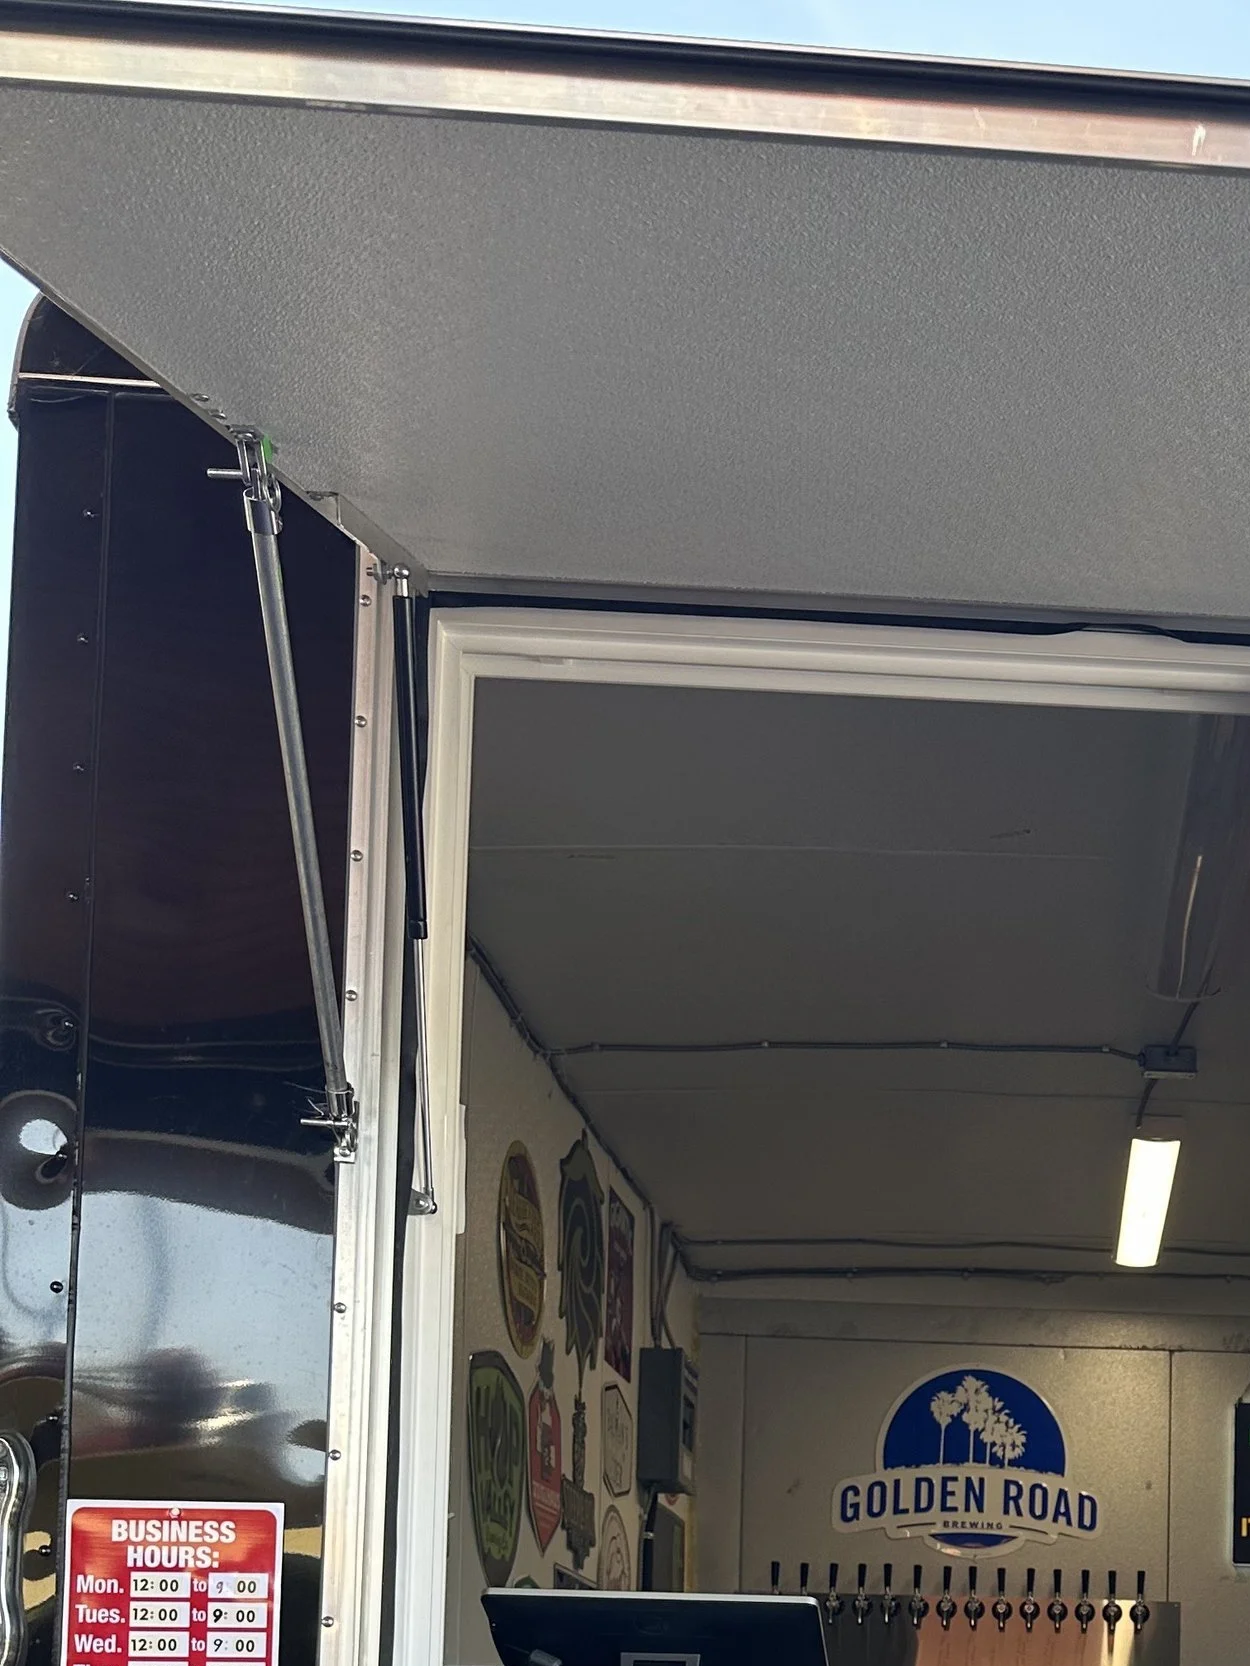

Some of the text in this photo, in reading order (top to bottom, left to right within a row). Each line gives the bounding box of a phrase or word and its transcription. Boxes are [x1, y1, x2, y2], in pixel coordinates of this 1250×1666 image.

[840, 1476, 1097, 1533] GOLDEN ROAD
[112, 1519, 236, 1543] BUSINESS
[943, 1520, 1003, 1530] BREWING
[127, 1546, 219, 1569] HOURS:
[76, 1575, 124, 1594] Mon.
[193, 1579, 207, 1593] to
[75, 1604, 126, 1625] Tues.
[193, 1608, 206, 1622] to
[75, 1634, 122, 1654] Wed.
[191, 1638, 206, 1651] to
